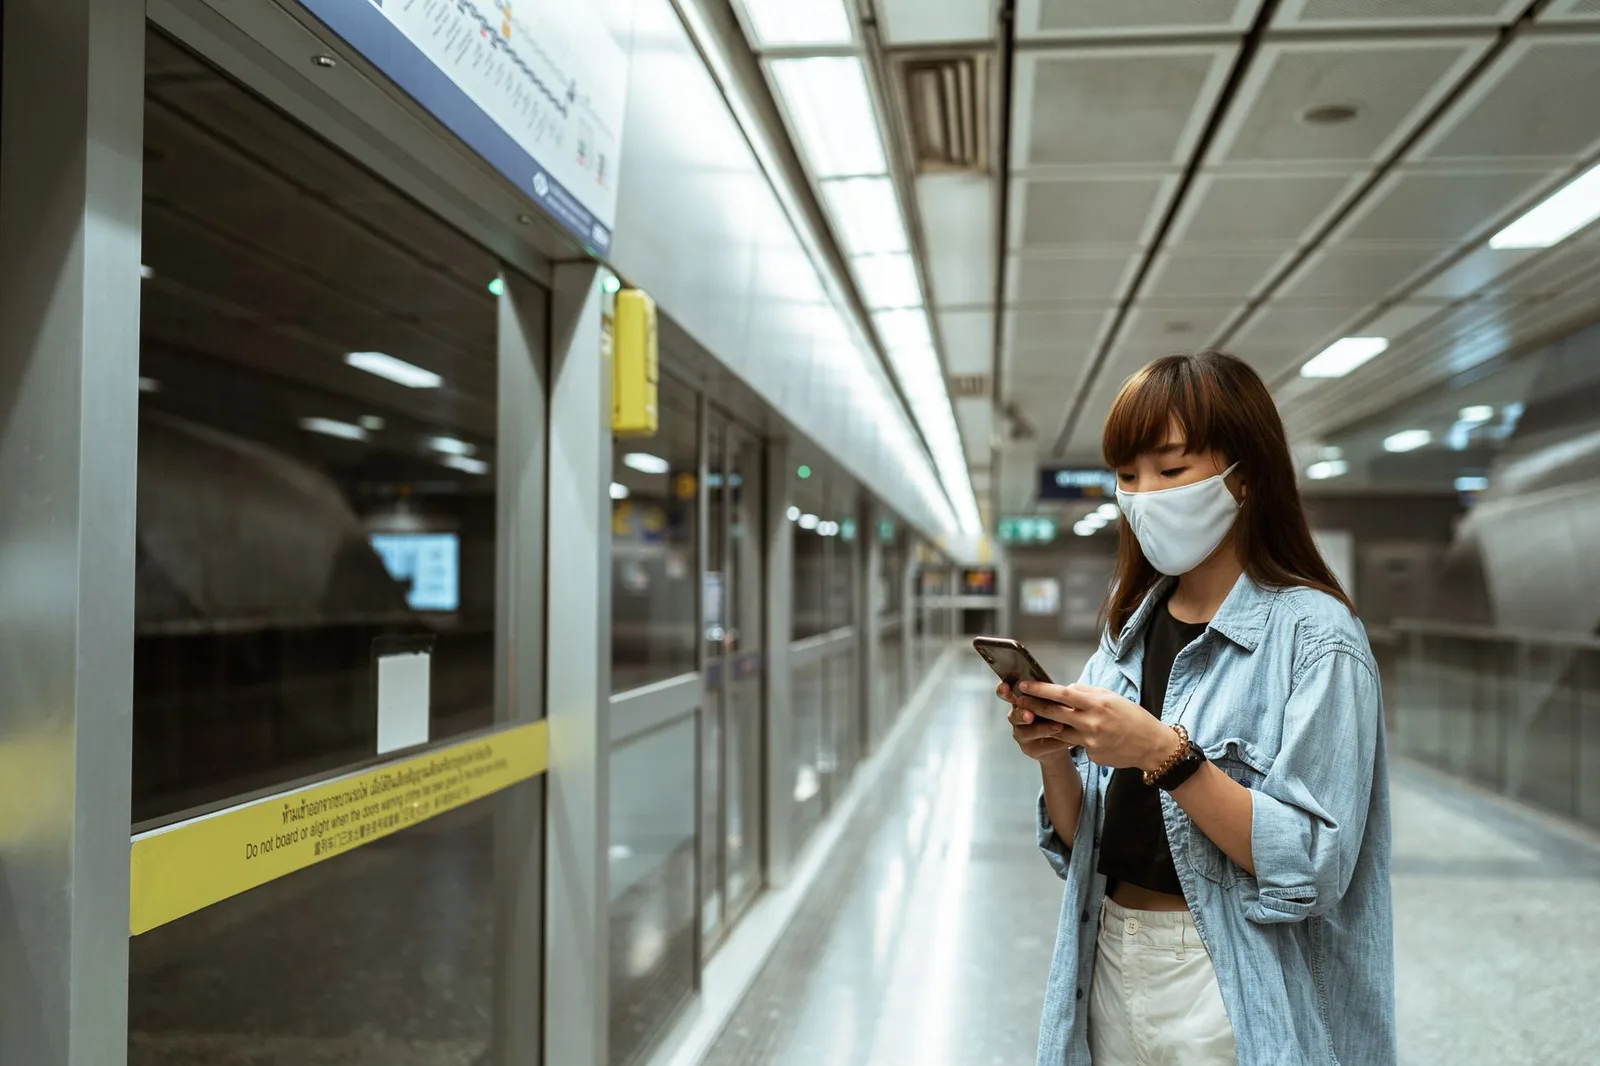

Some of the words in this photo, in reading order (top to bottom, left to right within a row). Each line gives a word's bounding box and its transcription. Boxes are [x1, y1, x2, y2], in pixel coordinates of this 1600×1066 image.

[246, 843, 258, 860] Do
[260, 836, 274, 855] not
[275, 827, 299, 849] board
[300, 827, 309, 841] or
[310, 818, 330, 838] alight
[331, 813, 349, 829] when
[351, 808, 361, 822] the
[362, 802, 379, 819] doors
